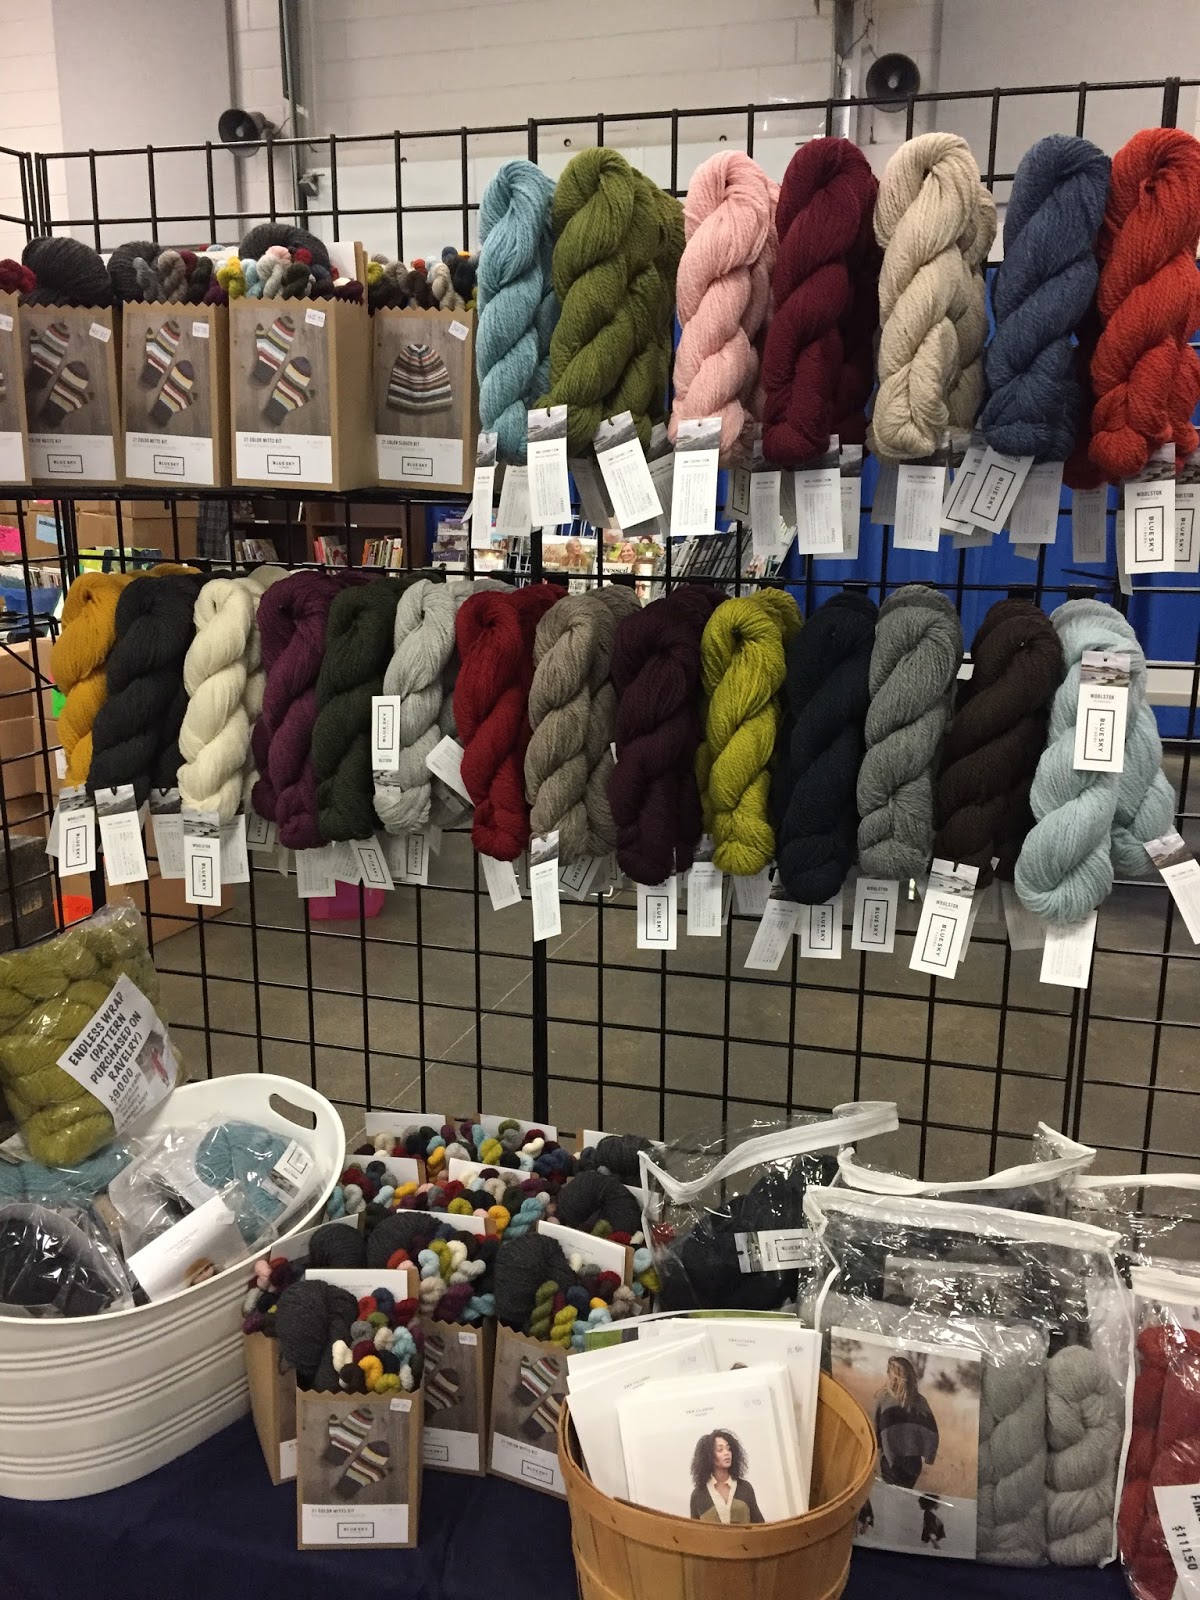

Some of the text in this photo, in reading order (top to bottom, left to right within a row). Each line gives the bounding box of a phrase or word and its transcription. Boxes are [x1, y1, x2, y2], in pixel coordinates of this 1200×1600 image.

[986, 476, 1005, 510] BLUE SKY
[572, 871, 580, 882] SKY
[935, 899, 959, 909] WOOLSTOK
[935, 924, 947, 957] BLUE SKY
[68, 991, 124, 1066] ENDLESS WRAP
[90, 1013, 126, 1062] (PATTERN
[90, 1010, 142, 1084] PURCHASED ON
[108, 1032, 143, 1082] RAVELRY)
[109, 1068, 133, 1105] $90.00
[1172, 1525, 1198, 1571] $111.50
